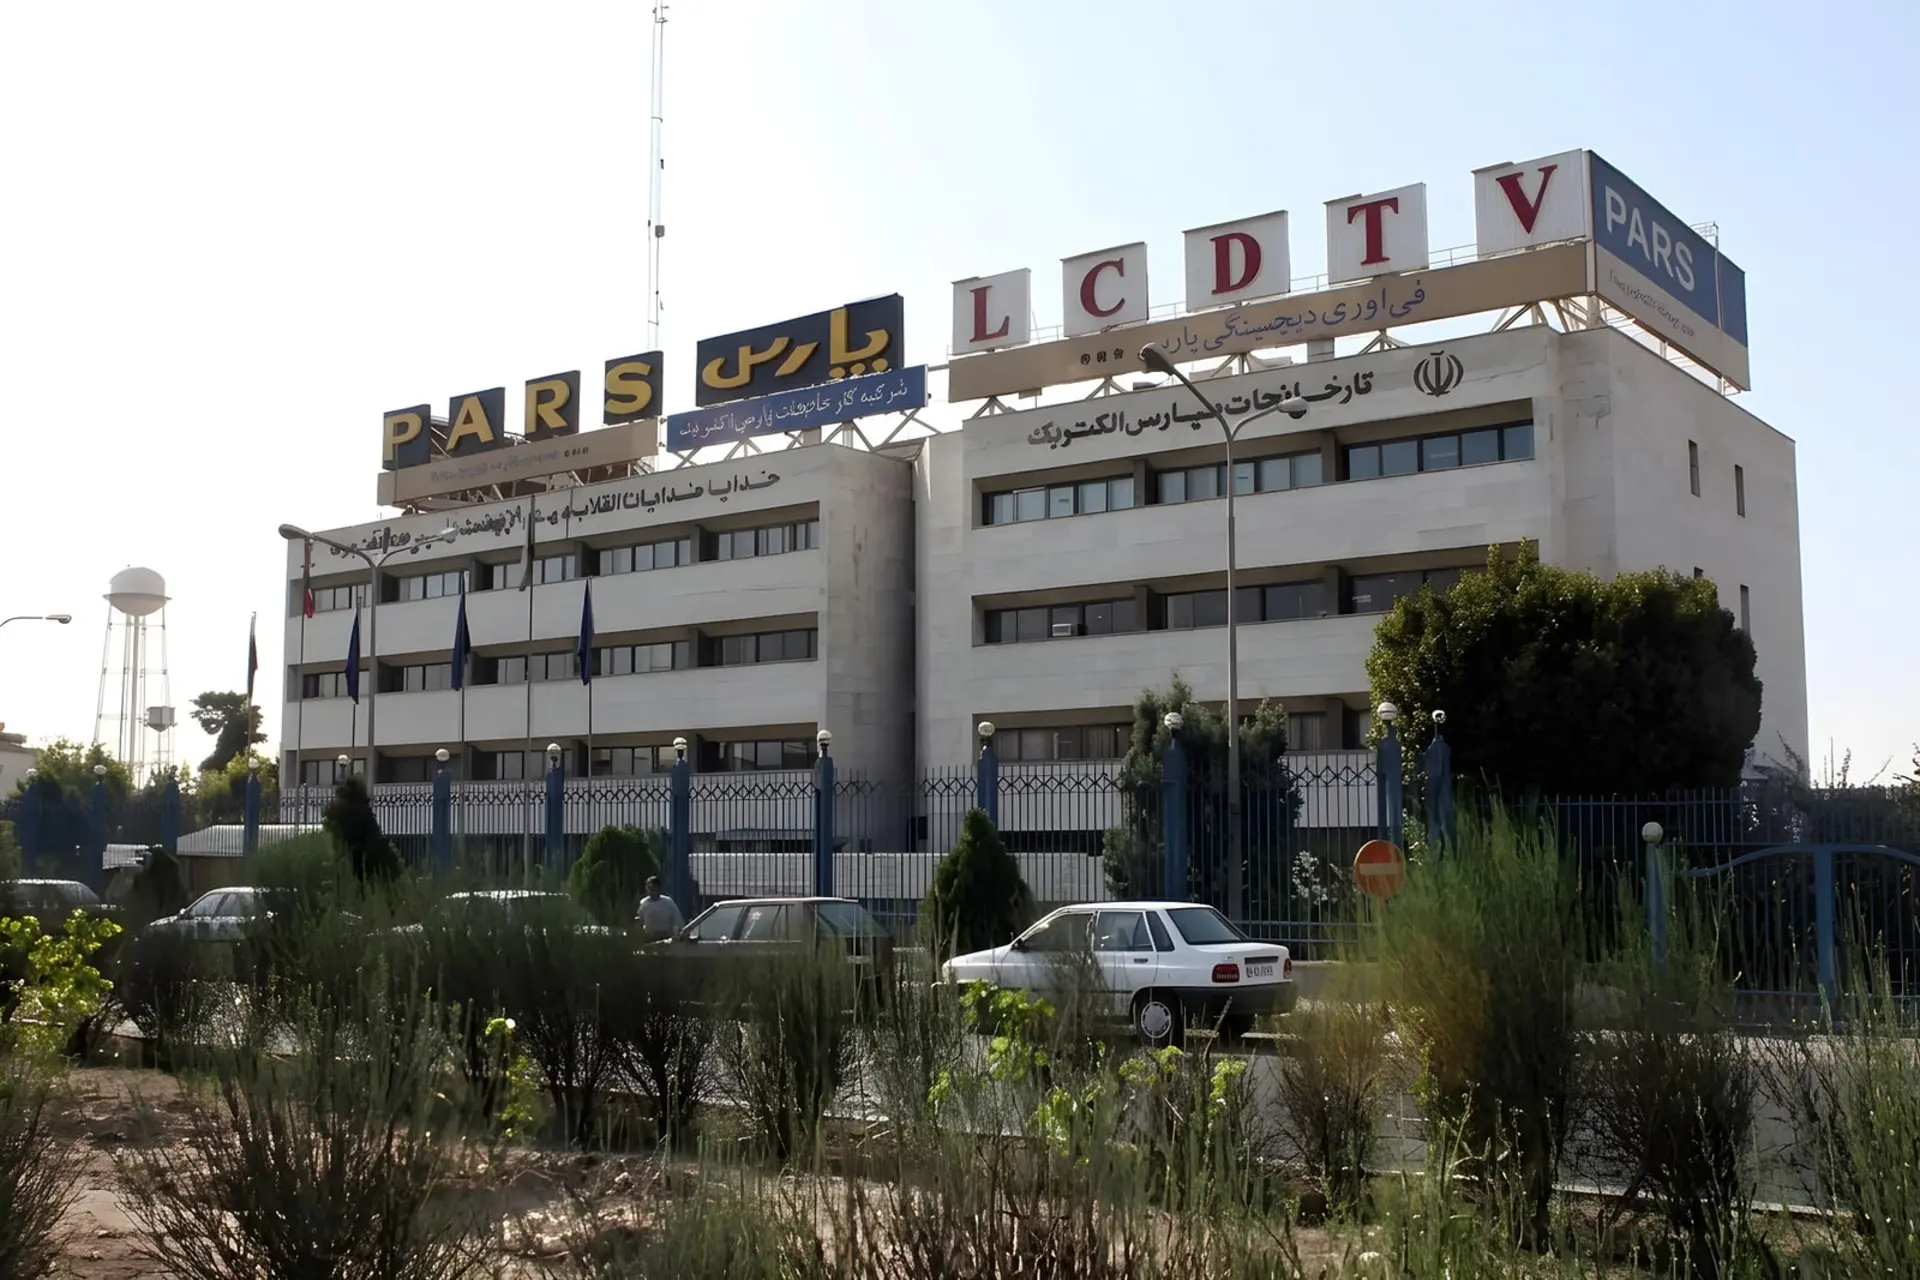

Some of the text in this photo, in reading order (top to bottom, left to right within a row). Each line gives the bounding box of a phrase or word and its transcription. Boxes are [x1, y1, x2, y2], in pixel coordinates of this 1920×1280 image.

[1604, 185, 1696, 292] PARS
[702, 308, 890, 389] پارس
[382, 361, 652, 462] PARS
